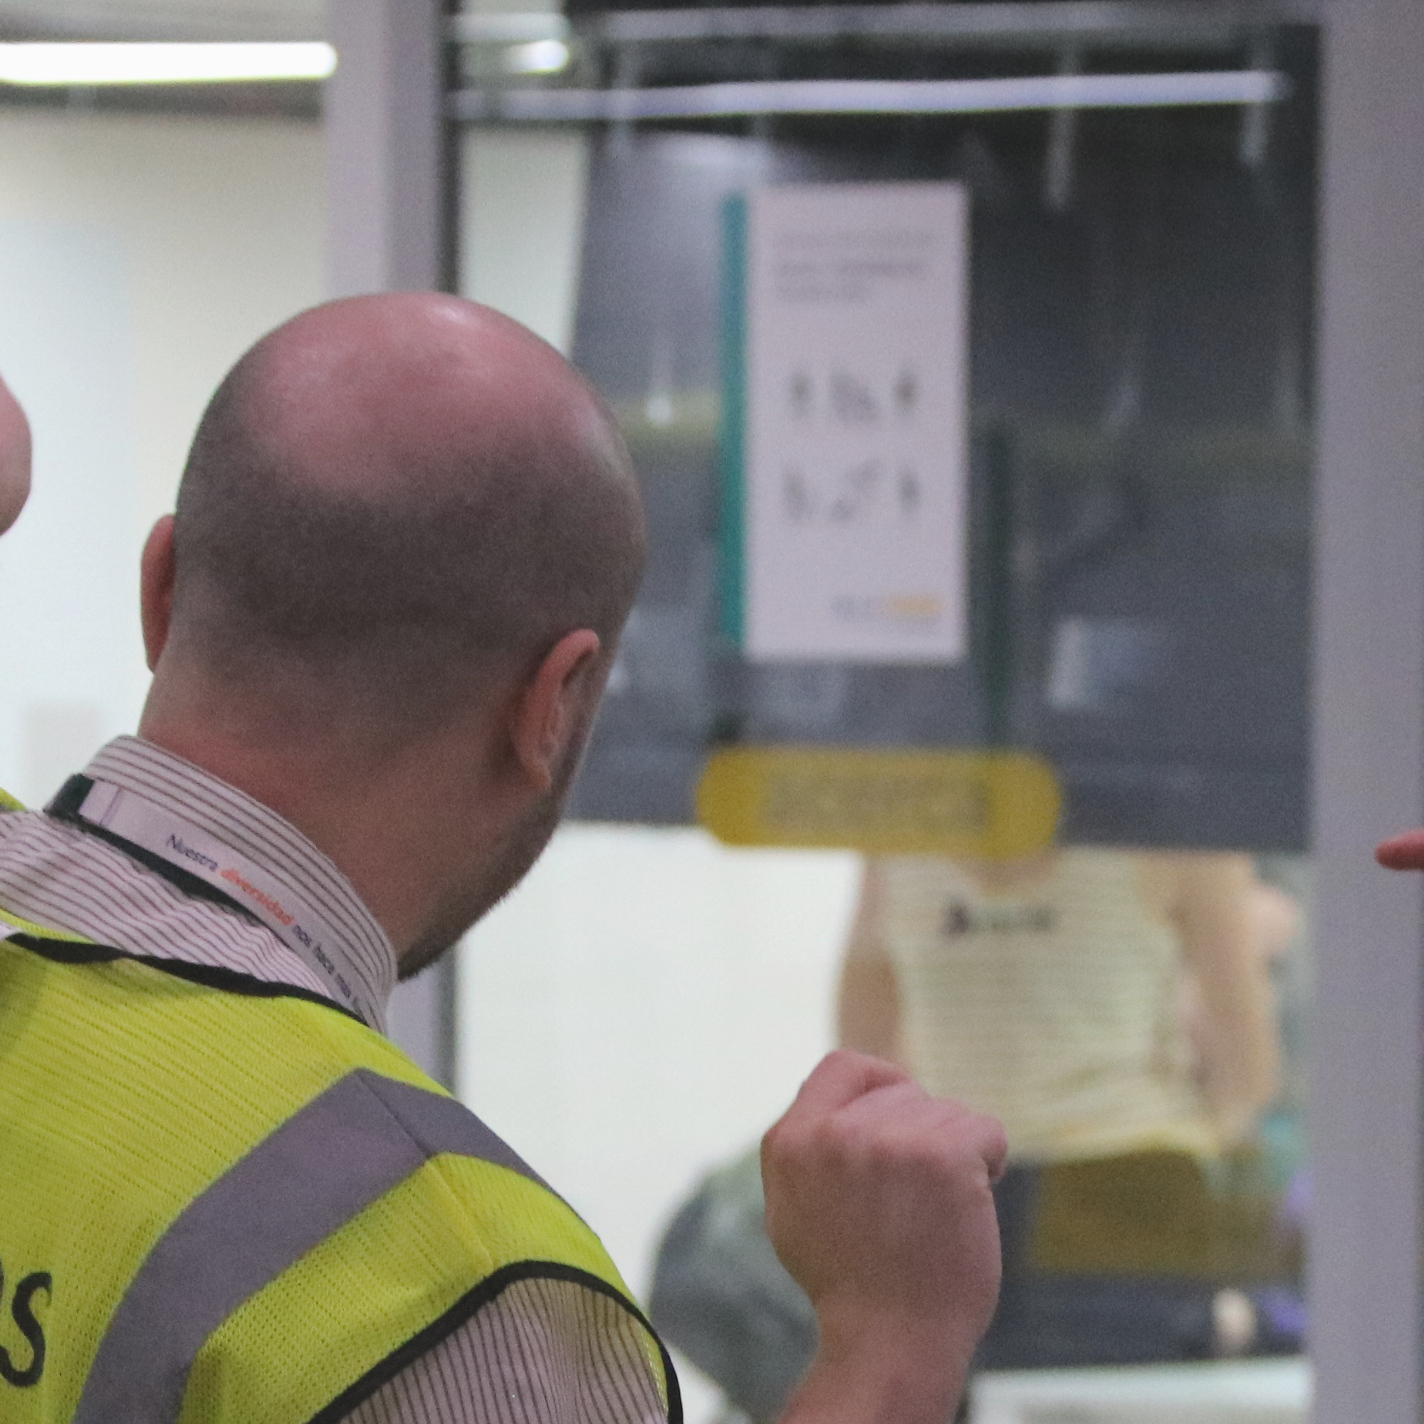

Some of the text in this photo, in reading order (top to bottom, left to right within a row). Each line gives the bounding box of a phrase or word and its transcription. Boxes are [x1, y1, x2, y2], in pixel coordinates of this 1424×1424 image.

[165, 834, 218, 872] Nuestra
[220, 868, 295, 926] diversidad
[292, 924, 312, 948] nos
